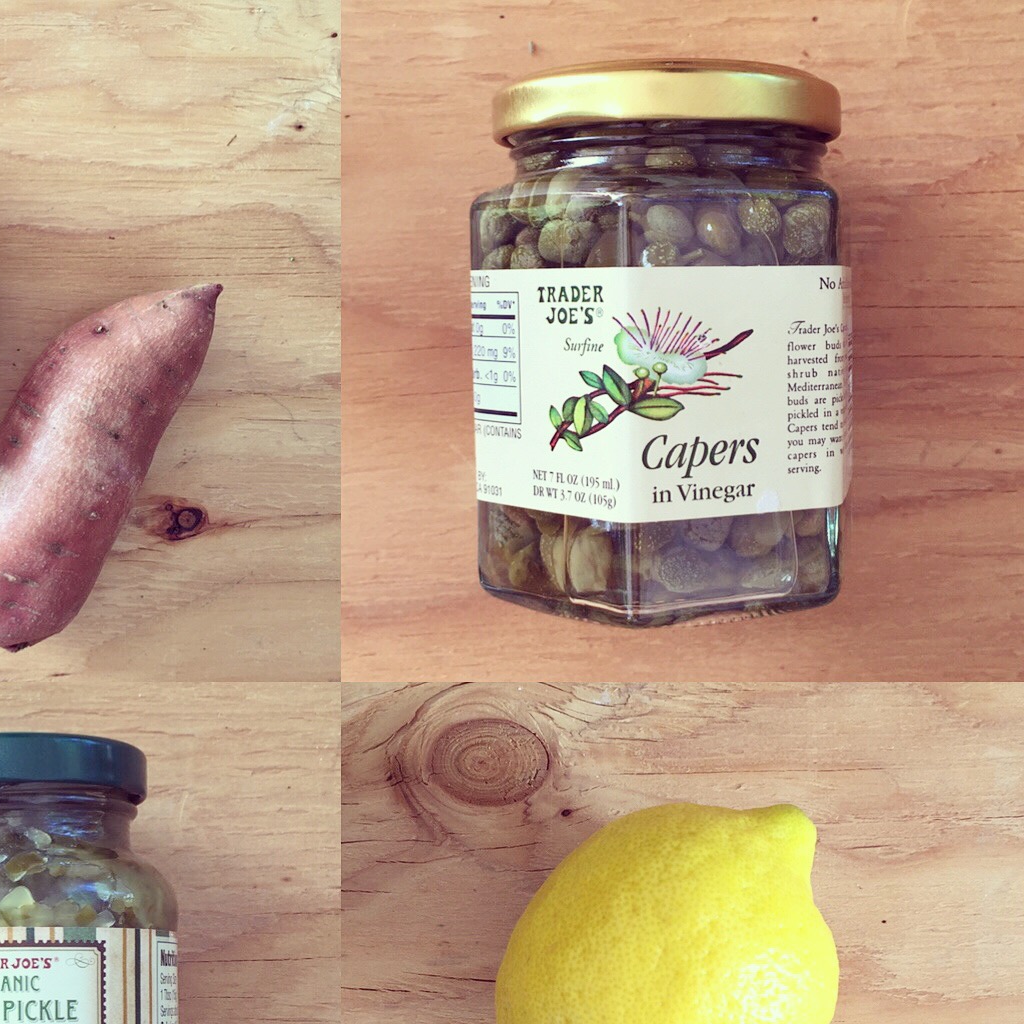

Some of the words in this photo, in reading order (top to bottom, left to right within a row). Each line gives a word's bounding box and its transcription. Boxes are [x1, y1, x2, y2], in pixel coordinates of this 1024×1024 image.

[819, 277, 836, 290] No
[537, 285, 604, 303] TRADER
[787, 320, 821, 335] Trader
[823, 324, 840, 336] Joe's
[503, 346, 516, 359] 9%
[563, 337, 605, 353] Surfine
[787, 341, 816, 352] flower
[787, 354, 828, 365] harvested
[787, 368, 818, 379] shrub
[787, 396, 809, 406] buds
[814, 397, 827, 405] are
[787, 408, 819, 422] pickled
[823, 407, 832, 418] in
[483, 424, 522, 440] (CONTAINS
[787, 423, 818, 435] Capers
[821, 420, 839, 431] tend
[787, 438, 804, 449] you
[808, 437, 826, 447] may
[641, 433, 760, 479] Capers
[787, 450, 817, 462] capers
[826, 447, 835, 458] in
[787, 463, 822, 475] serving.
[533, 469, 548, 482] NET
[556, 472, 565, 484] FL
[567, 473, 579, 486] OZ
[581, 475, 600, 489] (195
[533, 485, 545, 497] DR
[546, 486, 558, 499] WT
[560, 489, 572, 501] 3.7
[574, 491, 586, 503] OZ
[589, 493, 617, 510] (105g)
[652, 483, 672, 504] in
[676, 481, 756, 503] Vinegar
[3, 999, 79, 1022] PICKLE
